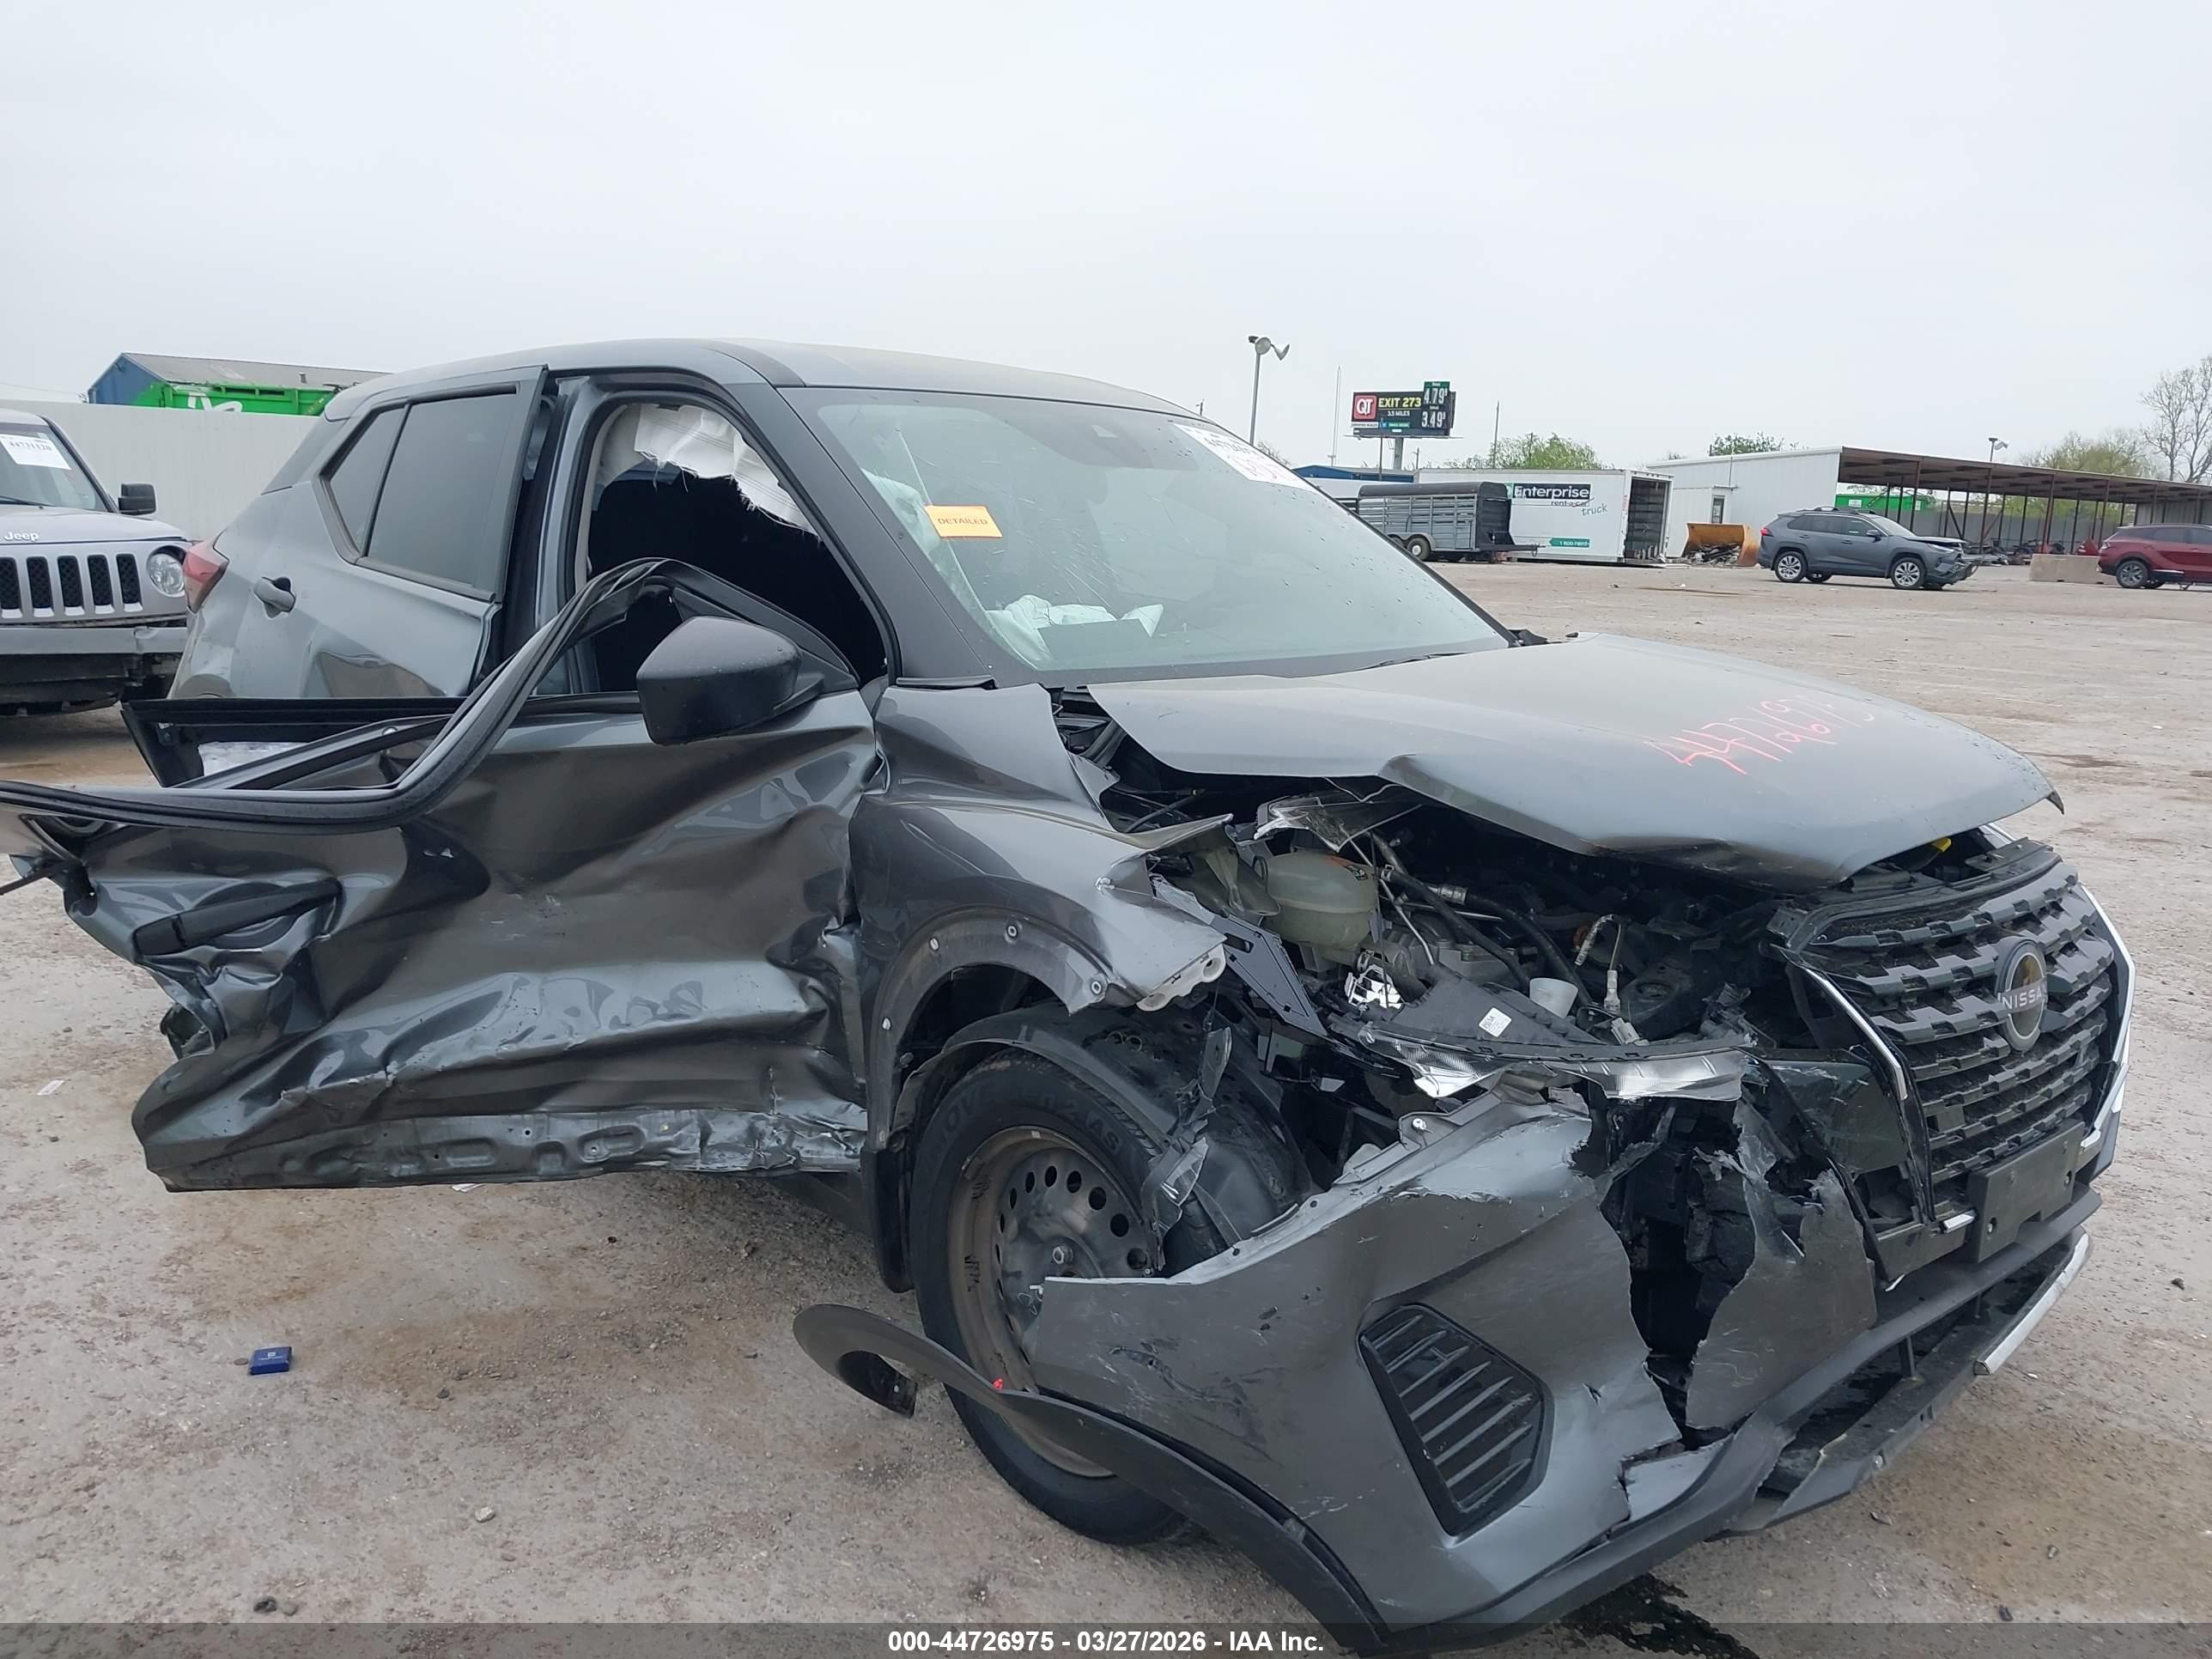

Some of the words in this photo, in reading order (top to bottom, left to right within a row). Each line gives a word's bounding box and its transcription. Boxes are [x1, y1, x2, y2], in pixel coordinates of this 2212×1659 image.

[1357, 398, 1373, 415] QT
[1378, 398, 1401, 408] EXIT
[1402, 398, 1422, 408] 273
[1514, 486, 1589, 498] Enterprise
[1582, 503, 1607, 516] truck
[3, 531, 40, 542] Jeep
